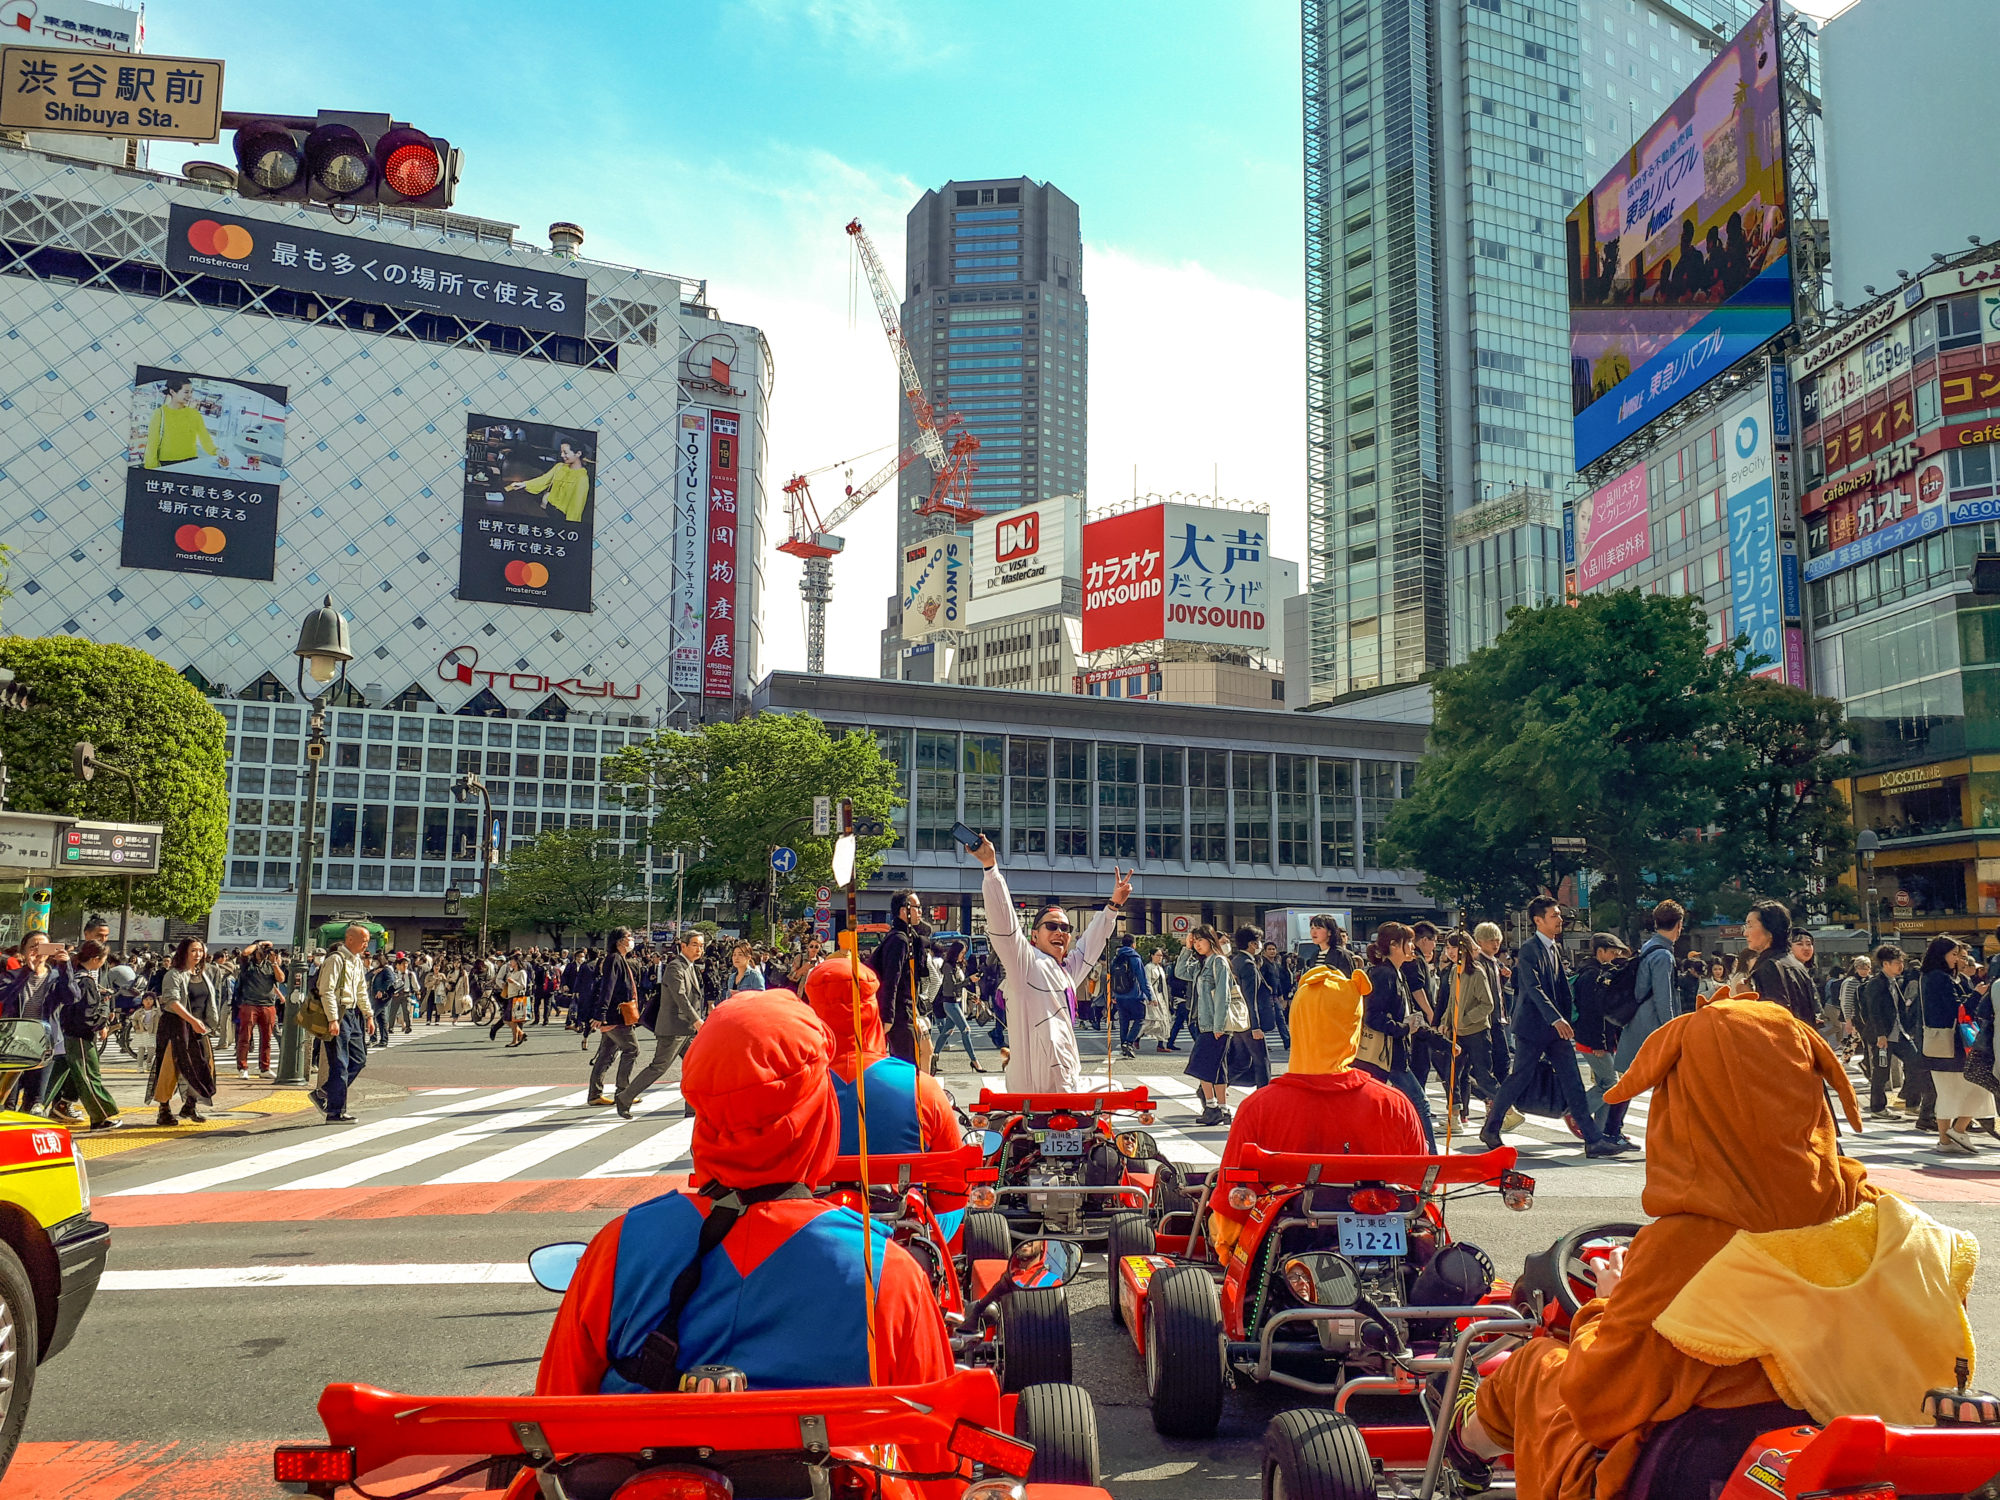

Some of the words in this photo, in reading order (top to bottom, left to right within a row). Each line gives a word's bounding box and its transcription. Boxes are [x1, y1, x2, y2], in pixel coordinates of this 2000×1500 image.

[35, 25, 130, 53] TOKYU
[43, 15, 130, 42] 東急東横店
[17, 59, 204, 104] 渋谷駅前
[44, 101, 129, 128] Shibuya
[138, 107, 180, 129] Sta.
[1623, 143, 1699, 235] 東急リバブル
[188, 255, 250, 272] mastercard
[271, 242, 567, 313] 最も多くの場所で使える
[1803, 301, 1896, 371] しゃぶしゃぶバイキング
[1648, 326, 1725, 403] 東急リバブル
[681, 380, 746, 397] TOKYU
[1774, 375, 1787, 432] 東急リバブル
[1803, 390, 1818, 412] 9F
[1825, 399, 1912, 465] プライス
[686, 432, 699, 488] TOKYU
[1731, 454, 1766, 484] eyecity
[1821, 470, 1873, 504] Caféレストラン
[1874, 445, 1921, 485] ガスト
[145, 480, 262, 505] 世界で最も多くの
[1606, 474, 1643, 502] 品川スキン
[1780, 470, 1791, 521] 献血ルーム
[1922, 480, 1942, 496] ガスト
[158, 500, 247, 521] 場所で使える
[1607, 492, 1639, 522] クリニック
[1856, 487, 1912, 537] ガスト
[478, 519, 579, 542] 世界で最も多くの
[999, 517, 1034, 557] DC
[1809, 524, 1828, 549] 7F
[1838, 521, 1918, 566] 英会話イーオン
[175, 552, 225, 563] mastercard
[489, 537, 566, 558] 場所で使える
[1168, 522, 1264, 575] 大声
[1588, 533, 1645, 577] 品川美容外科
[708, 487, 735, 659] 福岡物産展
[904, 548, 943, 610] SANKYO
[987, 577, 999, 589] DC
[1001, 565, 1046, 585] MasterCard
[994, 564, 1007, 576] DC
[1009, 558, 1028, 572] VISA
[1032, 557, 1039, 565] &
[1086, 549, 1161, 590] カラオケ
[1733, 504, 1758, 656] アイシティ
[1755, 496, 1777, 650] コンタクトの
[505, 586, 548, 596] mastercard
[945, 543, 963, 622] SANKYO
[1086, 578, 1162, 611] JOYSOUND
[1168, 573, 1266, 608] だそうぜ。
[1167, 604, 1265, 631] JOYSOUND
[474, 669, 640, 700] TOKYU
[1089, 670, 1114, 682] カラオケ
[1115, 665, 1146, 677] JOYSOUND
[41, 893, 48, 902] 7
[1052, 1141, 1079, 1152] 15-25
[1356, 1219, 1387, 1227] 江東区
[1357, 1232, 1401, 1250] 12-21
